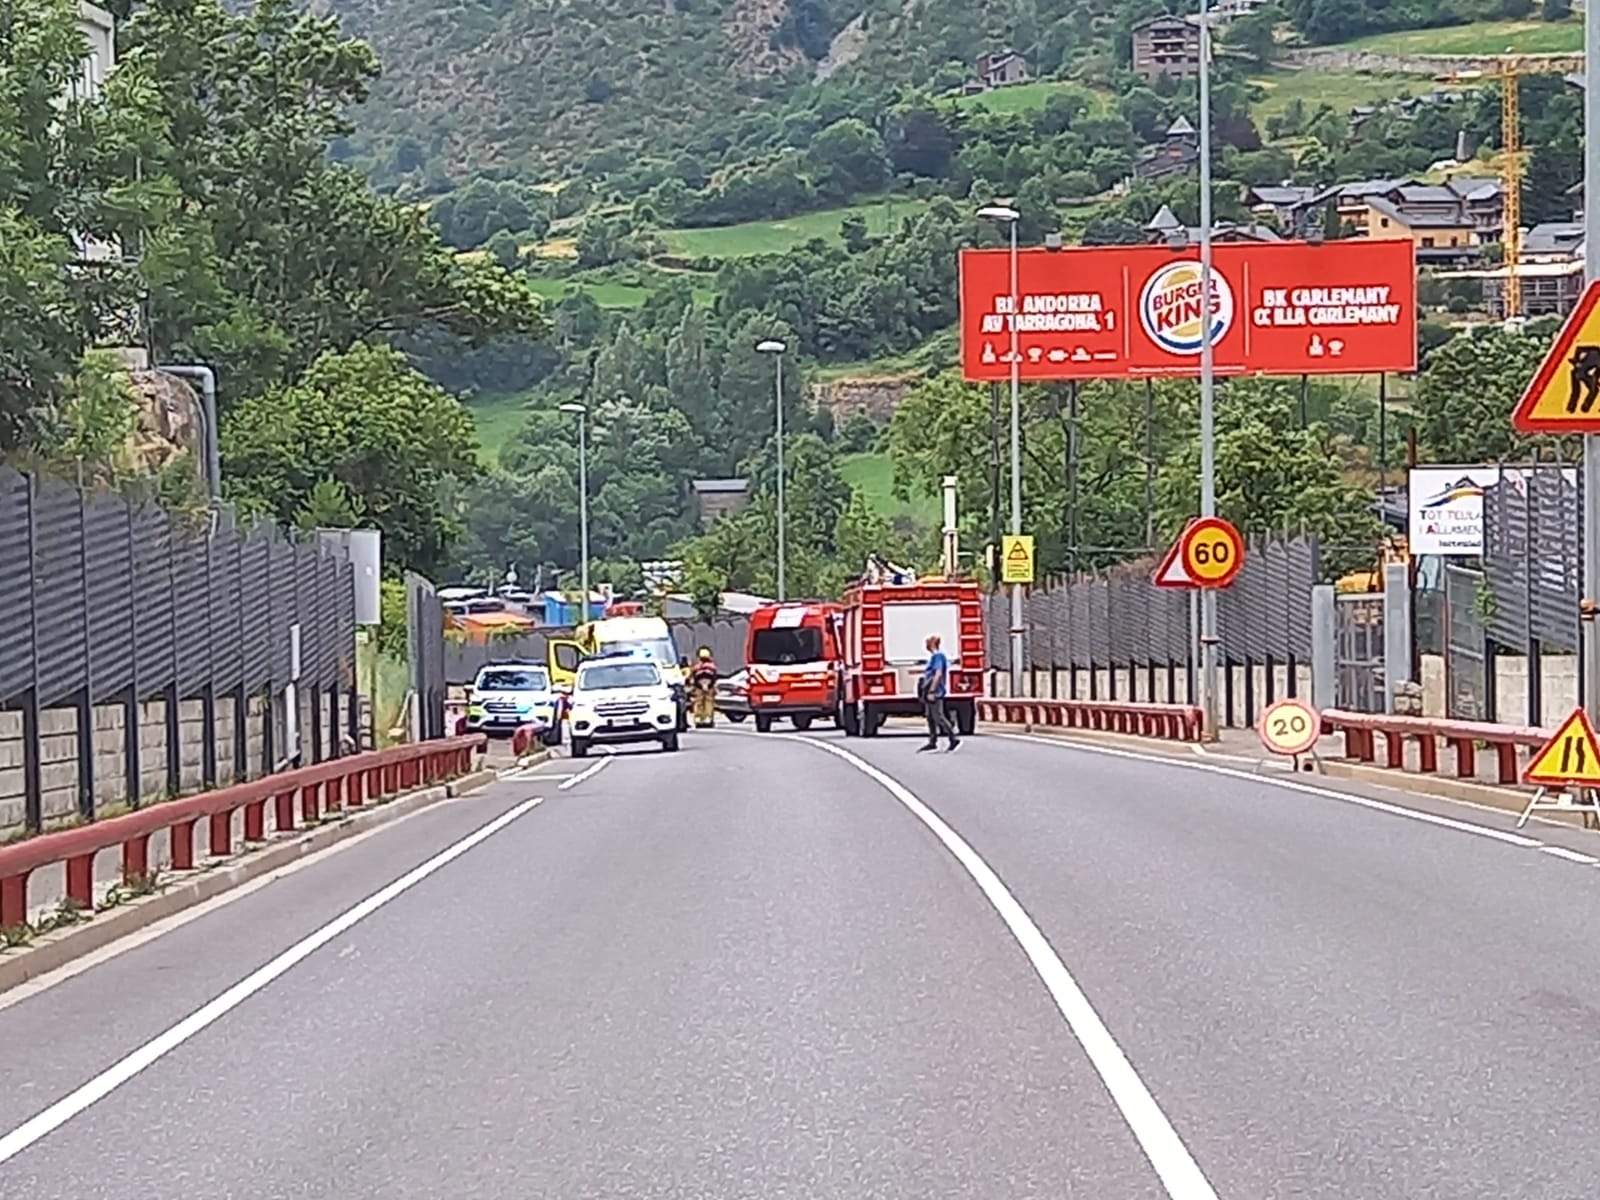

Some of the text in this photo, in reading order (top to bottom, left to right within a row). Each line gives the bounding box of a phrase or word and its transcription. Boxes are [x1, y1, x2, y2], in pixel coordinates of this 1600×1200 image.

[1023, 294, 1102, 312] ANDORRA
[1263, 287, 1390, 307] BK CARLEMANY
[1103, 310, 1115, 330] 1
[1157, 294, 1221, 332] KING
[1273, 307, 1307, 326] ILLA
[1308, 304, 1400, 325] CARLEMANY
[1419, 509, 1443, 520] TOT
[1195, 541, 1229, 565] 60
[1273, 715, 1306, 736] 20
